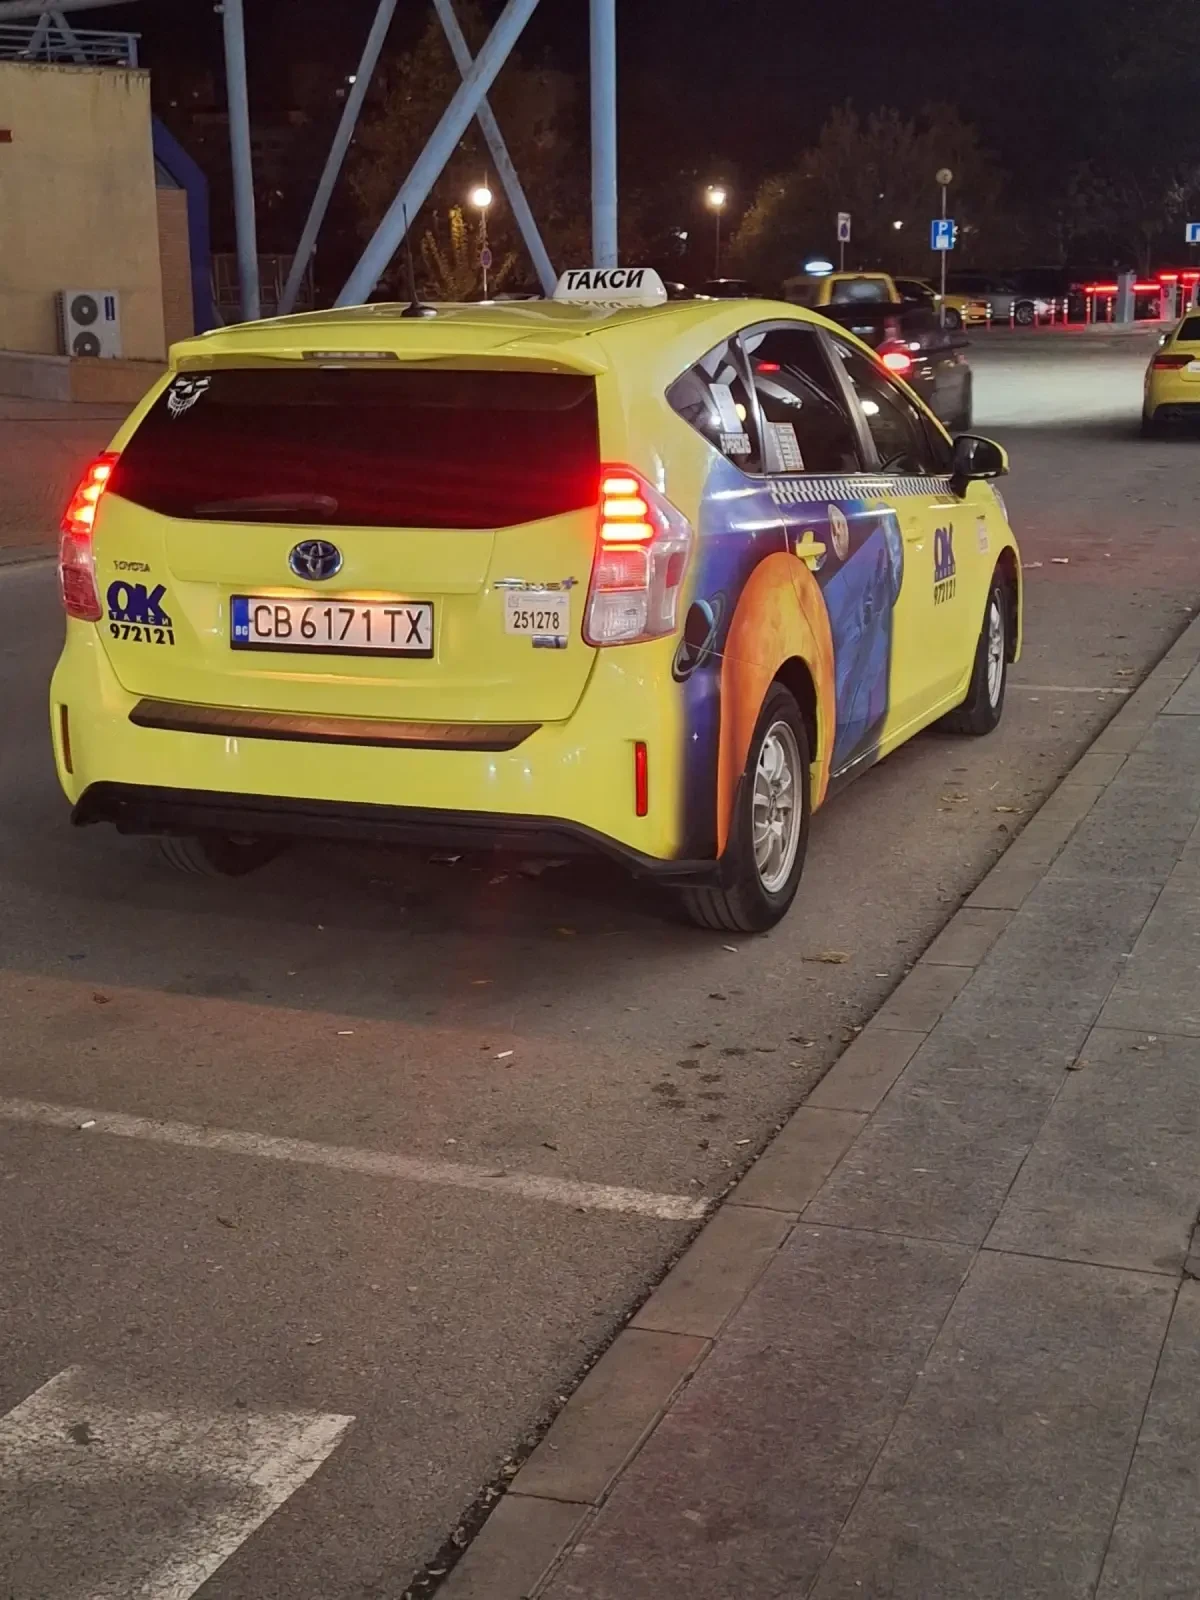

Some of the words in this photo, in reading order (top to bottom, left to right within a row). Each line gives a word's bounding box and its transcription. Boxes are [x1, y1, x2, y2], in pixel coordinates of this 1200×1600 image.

[939, 222, 948, 236] P
[567, 270, 644, 290] ТАКСИ
[113, 560, 150, 572] TOYOTA
[112, 612, 169, 625] ТАКСИ
[254, 605, 292, 638] CB
[301, 607, 371, 642] 6171
[384, 610, 423, 644] TX
[513, 611, 560, 629] 251278
[110, 623, 175, 645] 972121
[235, 625, 248, 636] BG
